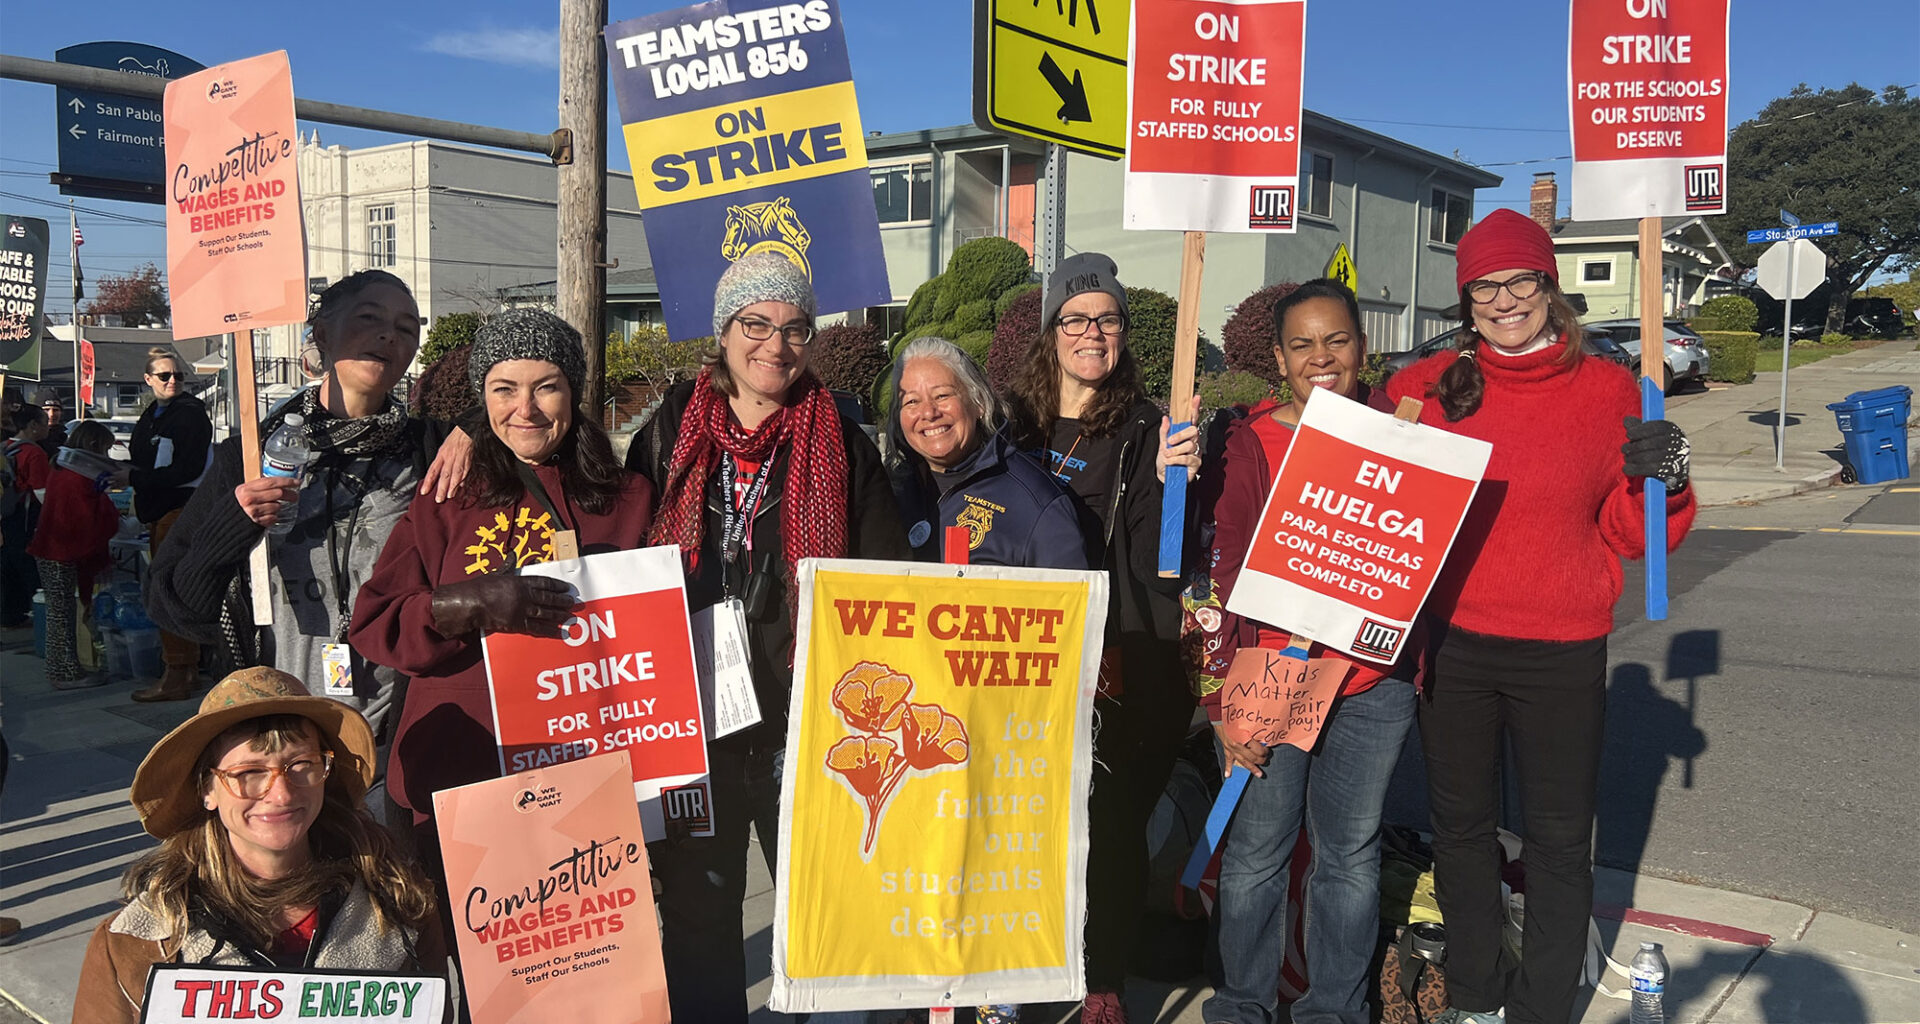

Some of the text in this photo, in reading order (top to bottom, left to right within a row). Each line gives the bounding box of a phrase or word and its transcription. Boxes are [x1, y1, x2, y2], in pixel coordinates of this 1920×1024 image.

[1626, 0, 1667, 19] ON
[616, 0, 832, 69] TEAMSTERS
[1194, 12, 1239, 43] ON
[1602, 35, 1691, 64] STRIKE
[650, 39, 808, 99] LOCAL 856
[1167, 53, 1266, 86] STRIKE
[1577, 79, 1722, 100] FOR THE SCHOOLS
[96, 103, 162, 123] San Pablo
[714, 106, 766, 138] ON
[1170, 98, 1262, 118] FOR FULLY
[1591, 105, 1706, 124] OUR STUDENTS
[97, 128, 155, 147] Fairmont
[1137, 121, 1295, 143] STAFFED SCHOOLS
[1616, 131, 1682, 149] DESERVE
[173, 131, 292, 203] Competitive
[651, 122, 847, 192] STRIKE
[178, 179, 286, 215] WAGES AND
[1688, 168, 1720, 198] UTR
[190, 202, 276, 234] BENEFITS
[1254, 189, 1290, 217] UTR
[199, 229, 272, 249] Support Our Students,
[1809, 228, 1823, 236] Ave
[24, 253, 34, 268] &
[208, 241, 263, 257] Staff Our Schools
[1065, 272, 1100, 297] KING
[7, 300, 35, 317] OUR
[722, 466, 731, 501] Teachers
[1354, 460, 1403, 495] EN
[725, 504, 733, 513] of
[963, 494, 1006, 514] TEAMSTERS
[1298, 481, 1424, 544] HUELGA
[731, 513, 746, 542] United
[1280, 511, 1423, 570] PARA ESCUELAS
[1274, 531, 1411, 590] CON PERSONAL
[1287, 557, 1383, 600] COMPLETO
[561, 610, 616, 647] ON
[834, 599, 1064, 644] WE CAN'T
[1360, 621, 1400, 651] UTR
[536, 651, 655, 701] STRIKE
[944, 650, 1059, 687] WAIT
[1263, 652, 1319, 684] Kids
[1228, 681, 1309, 700] Matter
[547, 698, 656, 737] FOR FULLY
[1222, 703, 1281, 726] Teacher
[1289, 697, 1325, 717] Fair
[1002, 713, 1052, 742] for
[1287, 714, 1320, 732] pay!
[512, 719, 697, 771] STAFFED SCHOOLS
[993, 751, 1048, 778] the
[539, 799, 561, 808] WAIT
[540, 786, 555, 794] WE
[666, 788, 706, 819] UTR
[934, 789, 1046, 820] future
[984, 830, 1044, 854] our
[465, 836, 642, 933] Competitive
[880, 867, 1042, 897] students
[473, 888, 637, 945] WAGES AND
[890, 908, 1042, 939] deserve
[496, 913, 625, 964] BENEFITS
[511, 942, 620, 977] Support Our Students,
[525, 956, 610, 985] Staff Our Schools
[175, 979, 422, 1020] THIS ENERGY
